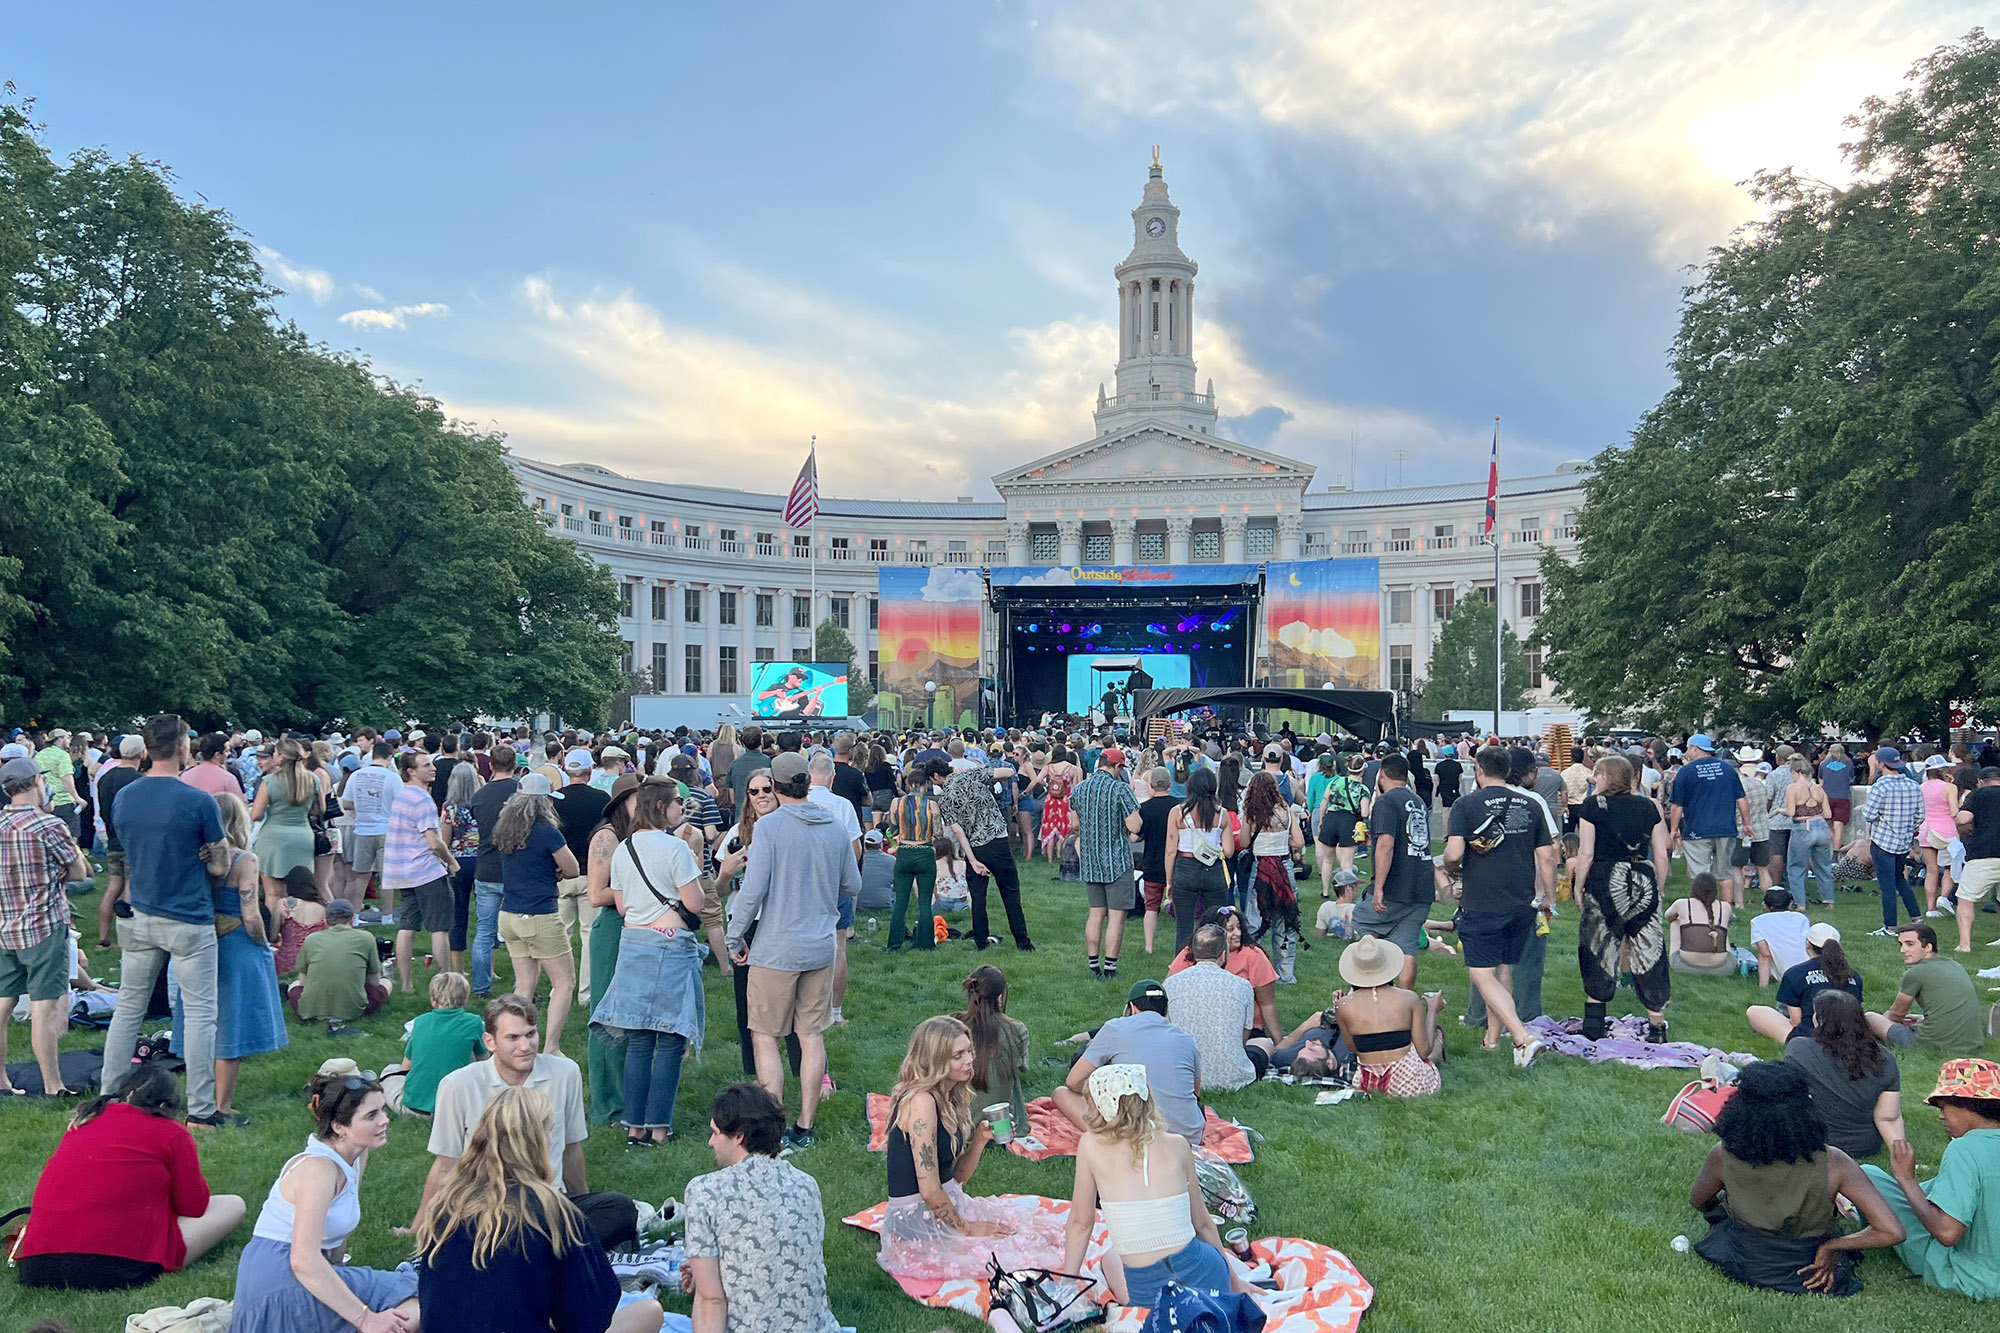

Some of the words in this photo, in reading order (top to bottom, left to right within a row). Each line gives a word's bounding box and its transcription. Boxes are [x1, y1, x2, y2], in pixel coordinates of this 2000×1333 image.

[1015, 498, 1057, 508] ERECTED
[1060, 498, 1074, 507] BY
[1076, 497, 1094, 506] THE
[1097, 496, 1131, 506] PEOPLE
[1137, 494, 1160, 505] CITY
[1162, 494, 1184, 504] AND
[1234, 492, 1247, 502] OF
[1251, 491, 1293, 501] DENVER
[1070, 566, 1122, 580] Outside
